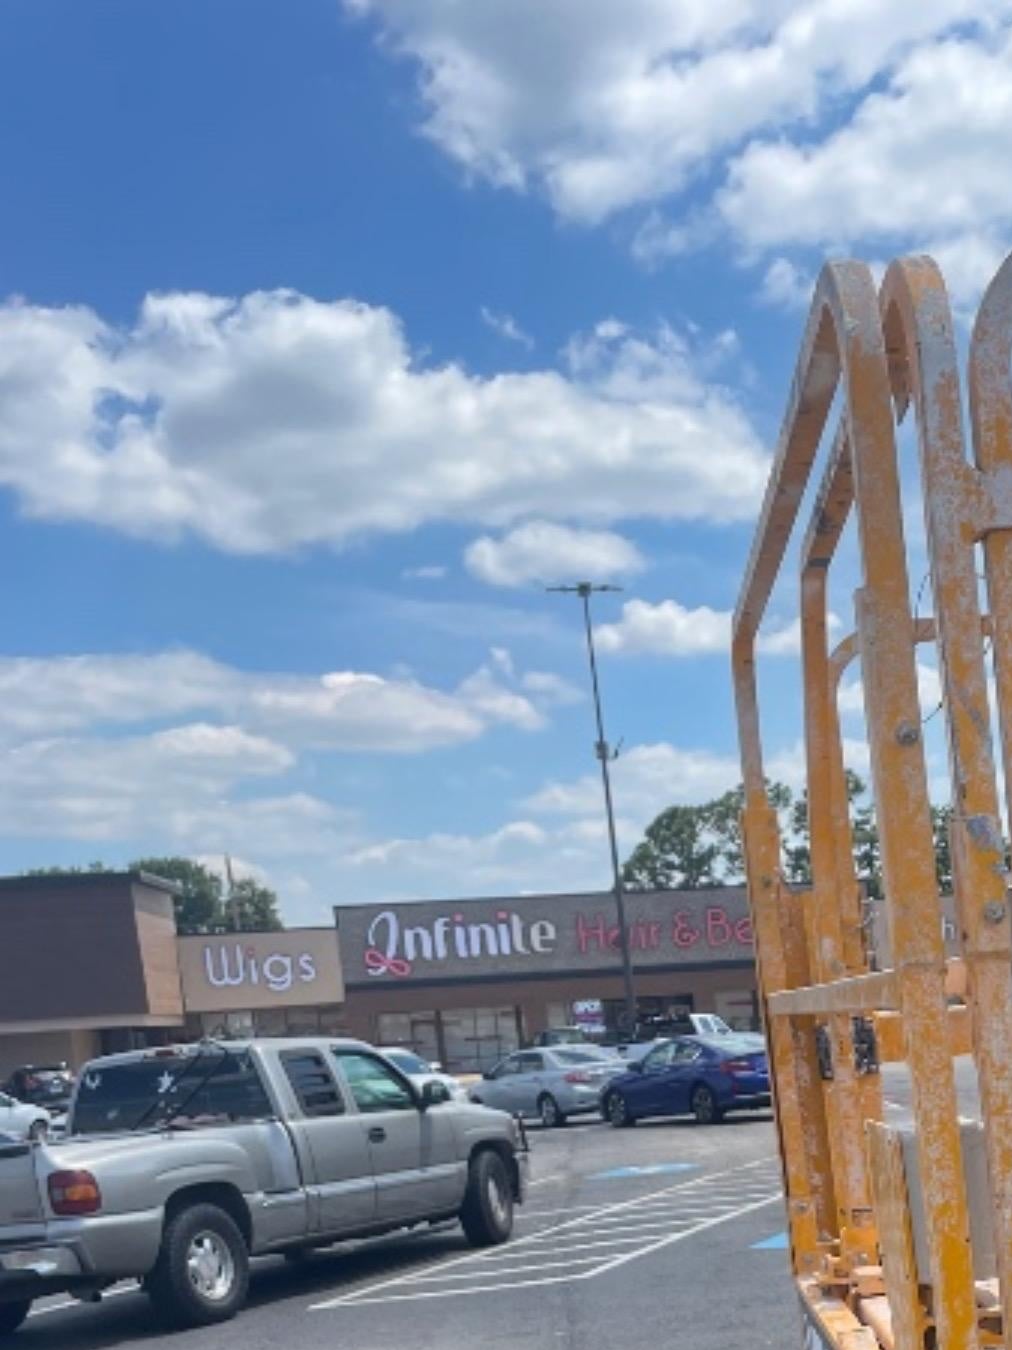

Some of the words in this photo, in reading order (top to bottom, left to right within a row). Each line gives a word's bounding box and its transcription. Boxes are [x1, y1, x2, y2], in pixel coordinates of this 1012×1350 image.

[204, 944, 316, 991] Wigs
[365, 911, 555, 979] Infinite
[672, 909, 701, 949] &
